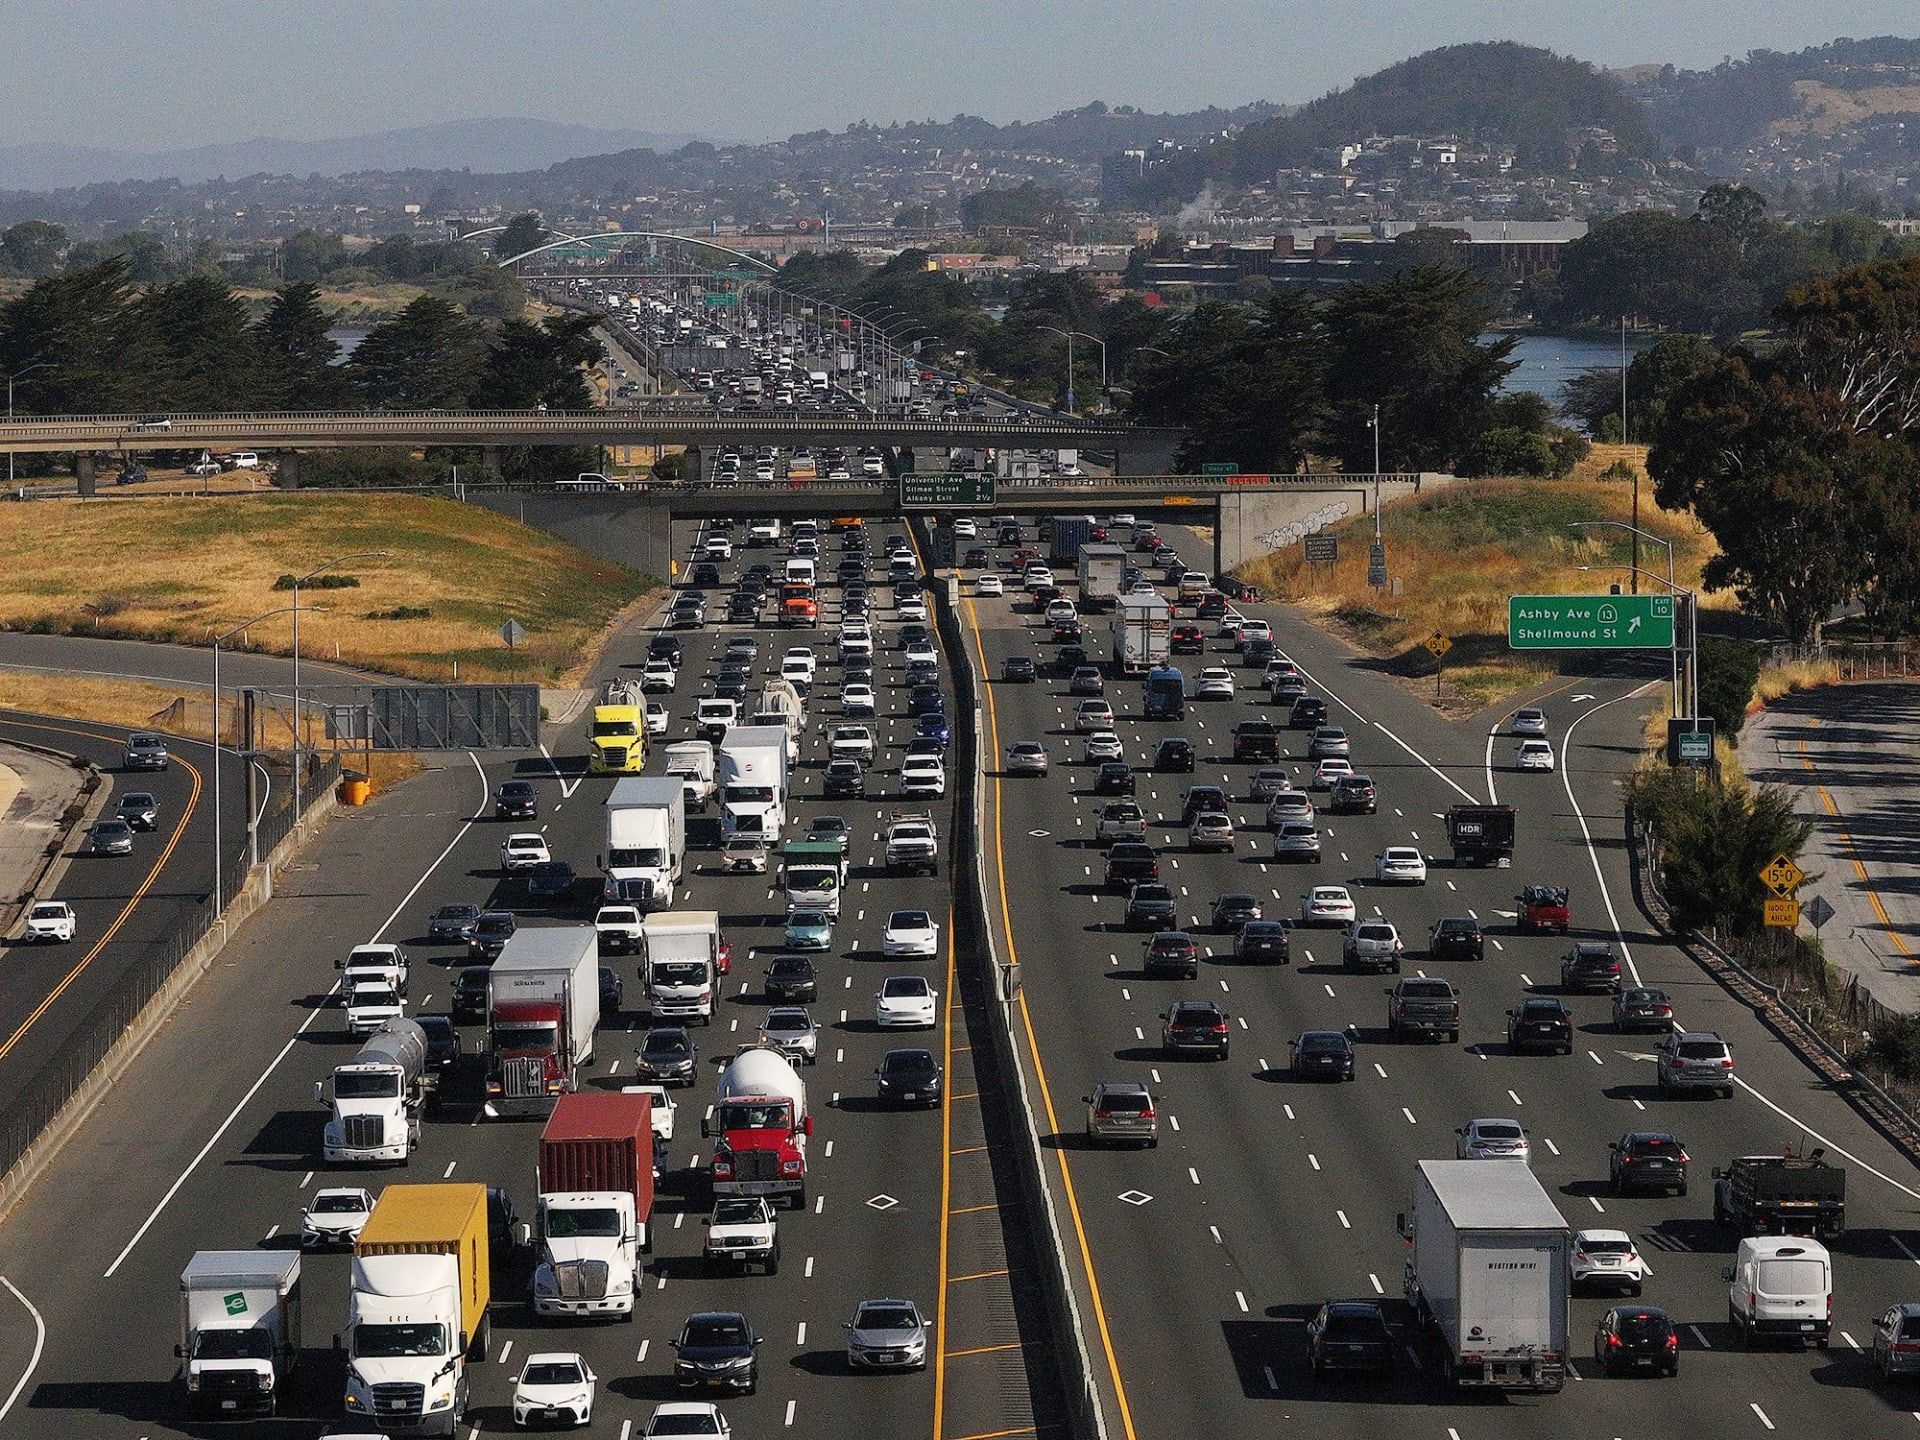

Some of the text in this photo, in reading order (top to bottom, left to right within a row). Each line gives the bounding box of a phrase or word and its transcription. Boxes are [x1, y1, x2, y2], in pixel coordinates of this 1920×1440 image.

[905, 476, 945, 484] University
[906, 494, 933, 502] Albany
[1657, 606, 1668, 614] 10
[1518, 609, 1613, 621] Ashby Ave 13
[1518, 629, 1617, 639] Shellmound St
[1460, 825, 1480, 833] HDR
[1768, 904, 1784, 912] 1600
[1488, 1262, 1518, 1270] WESTERN
